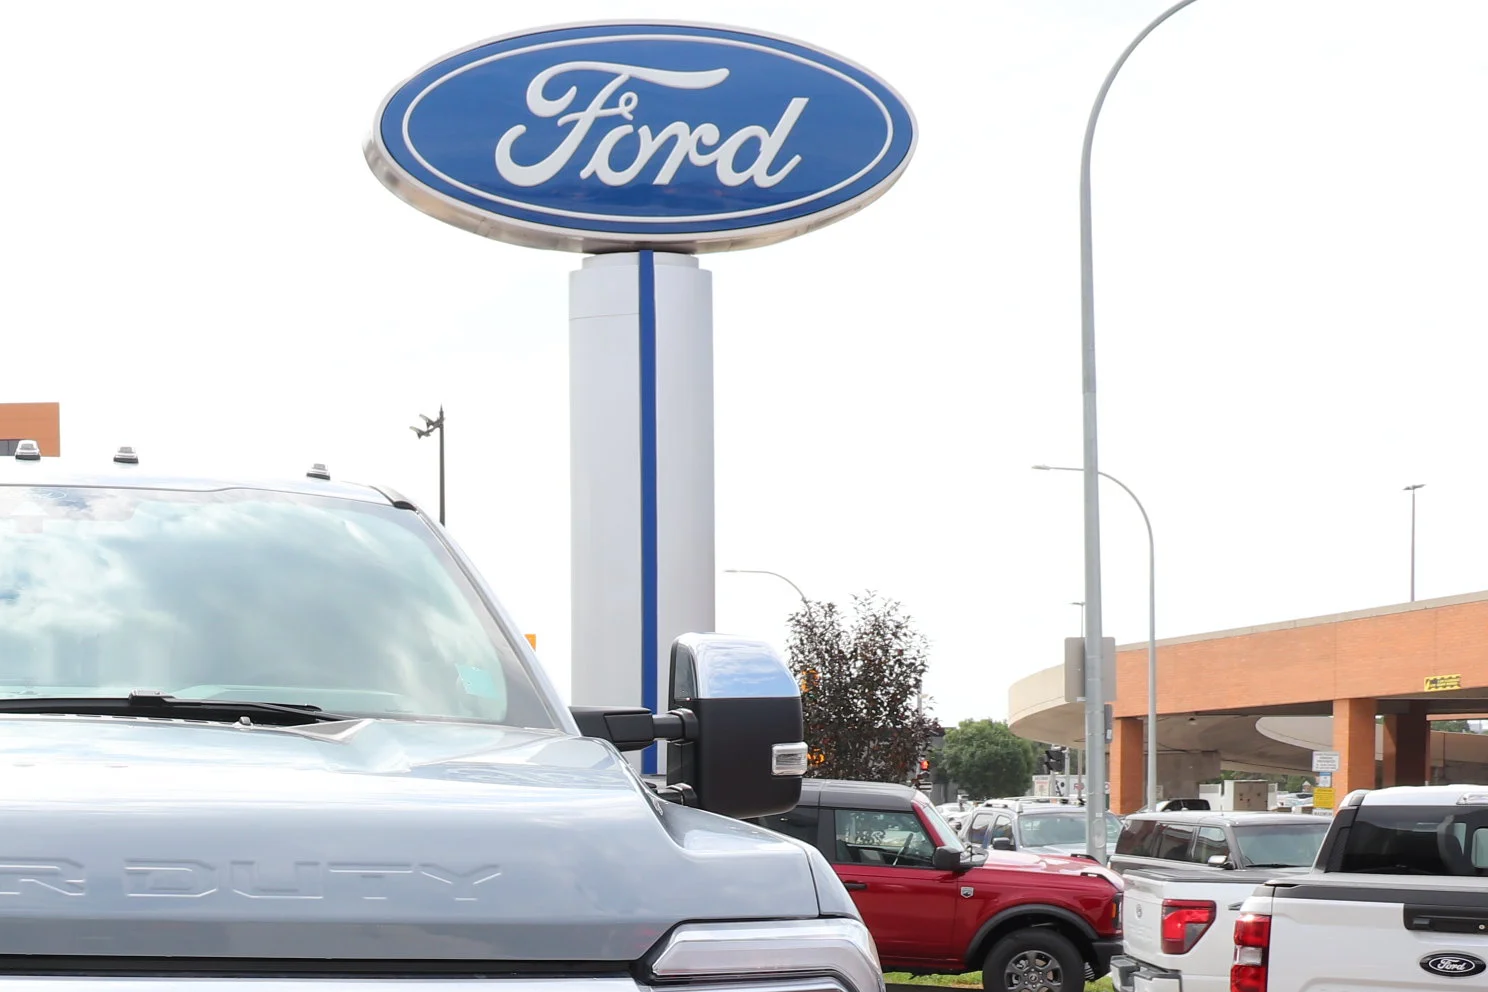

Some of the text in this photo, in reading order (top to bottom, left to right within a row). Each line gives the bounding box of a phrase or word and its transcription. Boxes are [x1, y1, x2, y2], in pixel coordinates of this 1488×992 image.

[495, 61, 809, 188] Ford
[124, 858, 502, 900] DUTY
[1437, 958, 1466, 971] Ford
